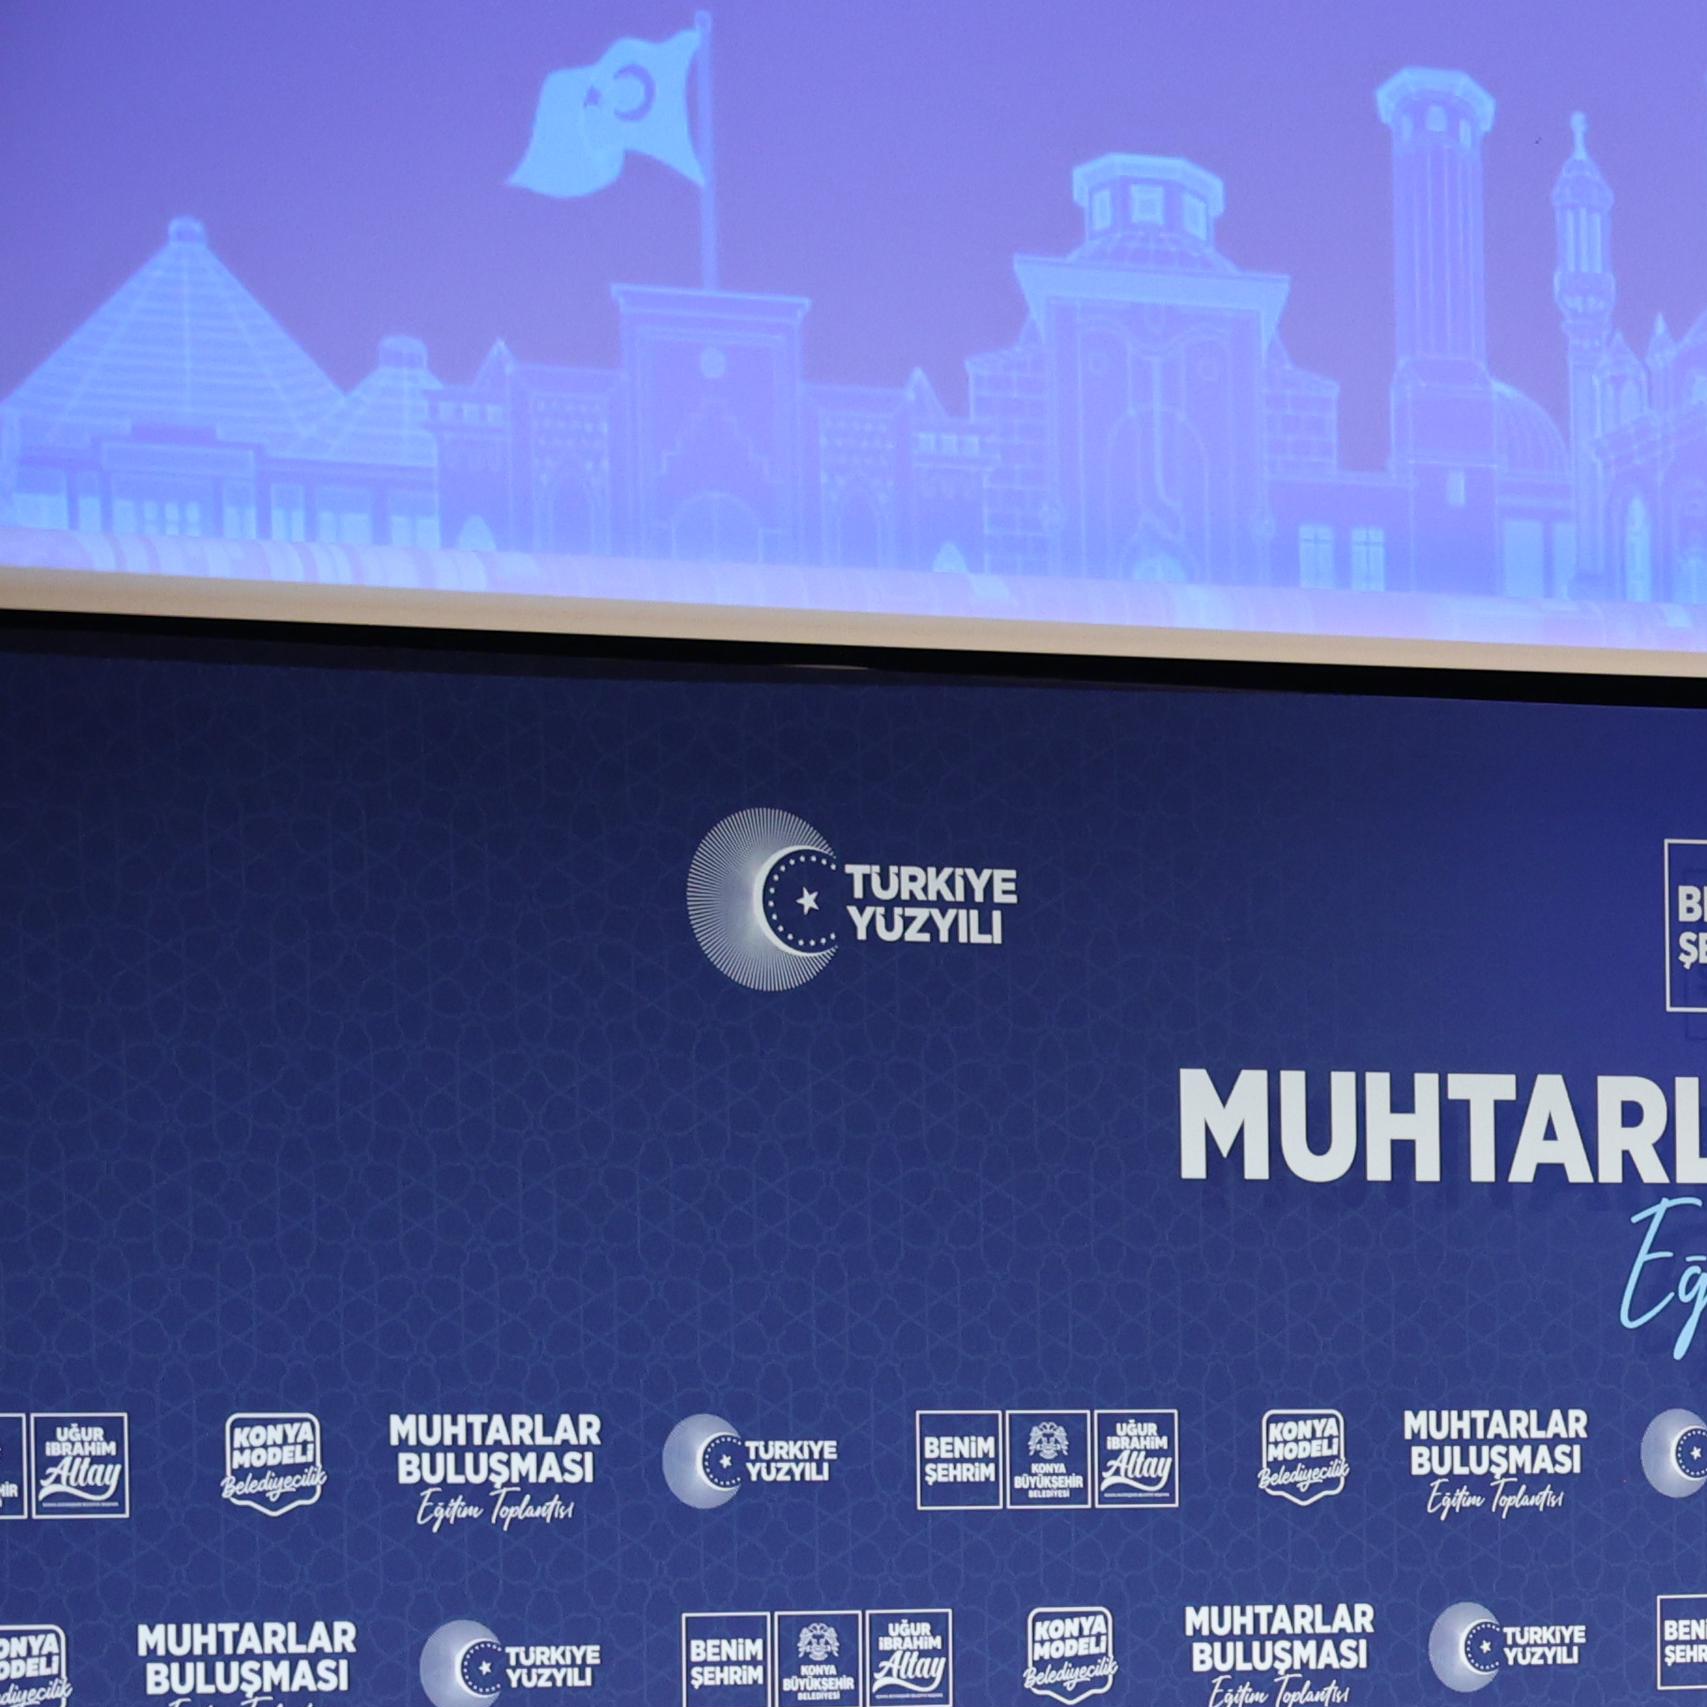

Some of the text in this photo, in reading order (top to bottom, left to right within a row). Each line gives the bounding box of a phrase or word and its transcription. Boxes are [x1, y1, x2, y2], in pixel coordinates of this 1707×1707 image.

[233, 1422, 314, 1448] KONYA
[390, 1414, 600, 1446] MUHTARLAR
[1116, 1420, 1157, 1437] UĞUR
[1404, 1409, 1587, 1439] MUHTARLAR
[232, 1444, 314, 1469] MODELİ
[925, 1436, 994, 1458] BENİM
[1107, 1436, 1167, 1450] İBRAHİM
[398, 1452, 593, 1489] BULUŞMASI
[925, 1463, 995, 1485] ŞEHRİM
[1032, 1463, 1066, 1474] KONYA
[1101, 1449, 1172, 1491] Altay
[1412, 1444, 1580, 1480] BULUŞMASI
[221, 1464, 327, 1501] Belediyecilik
[417, 1488, 483, 1532] Eğitim
[1427, 1479, 1485, 1520] Eğitim
[1035, 1615, 1107, 1641] KONYA
[1186, 1604, 1374, 1636] MUHTARLAR
[138, 1621, 356, 1656] MUHTARLAR
[1034, 1635, 1107, 1660] MODELİ
[1023, 1655, 1118, 1691] Belediyecilik
[1193, 1639, 1366, 1675] BULUŞMASI
[147, 1659, 348, 1699] BULUŞMASI
